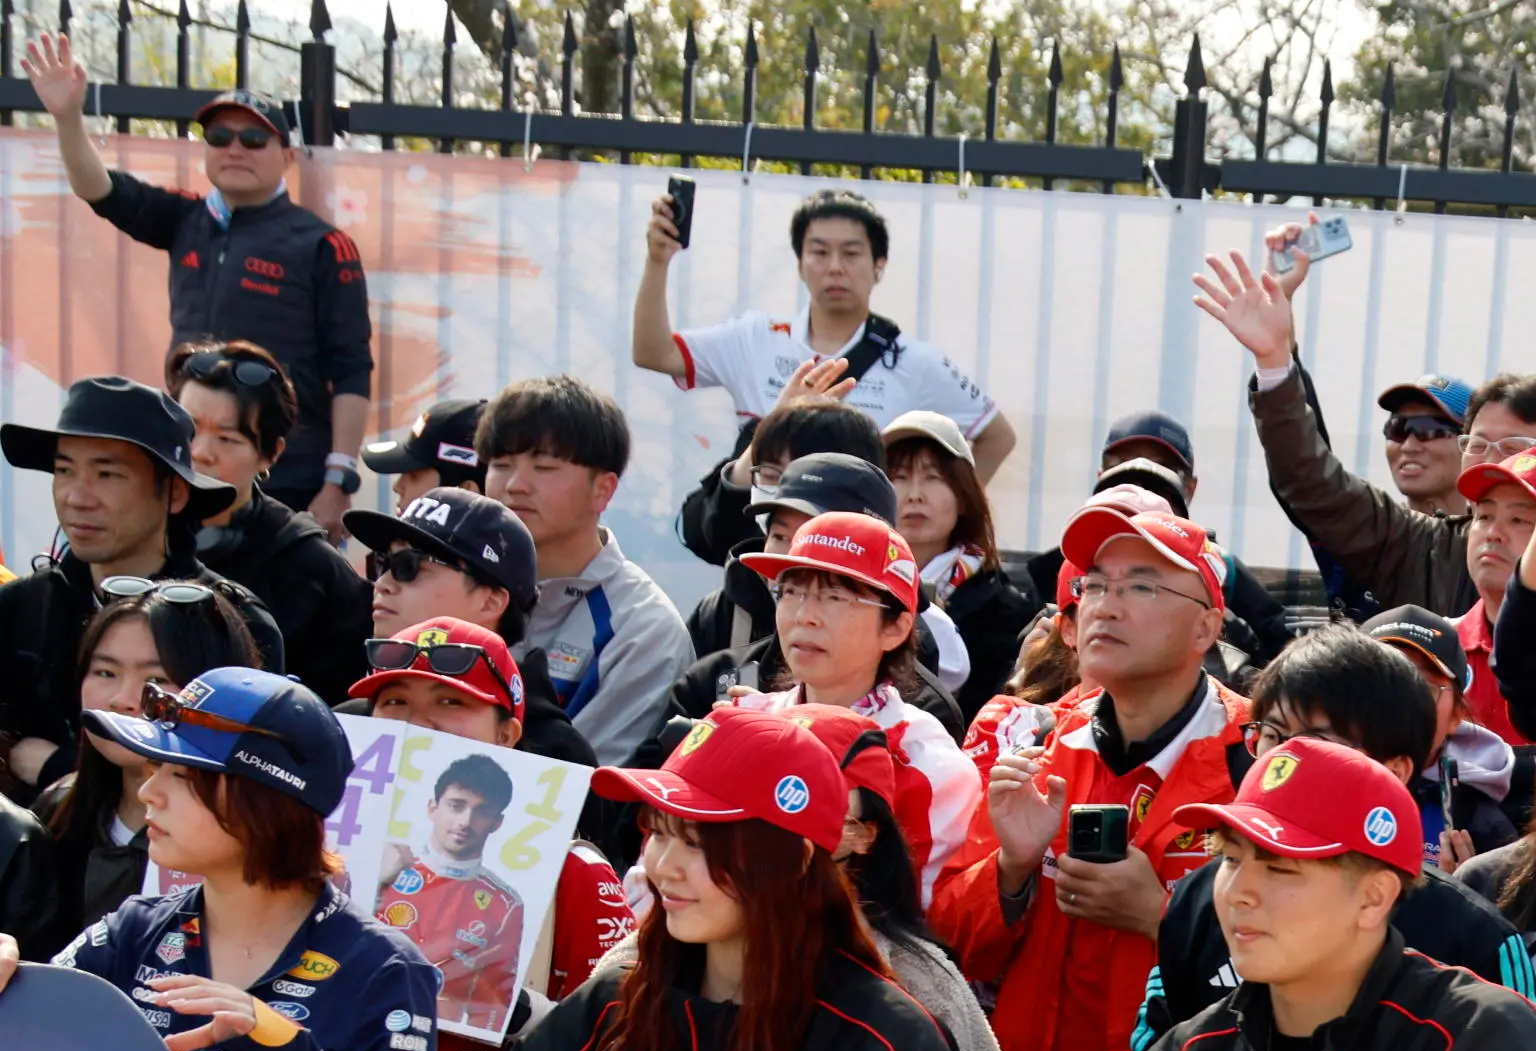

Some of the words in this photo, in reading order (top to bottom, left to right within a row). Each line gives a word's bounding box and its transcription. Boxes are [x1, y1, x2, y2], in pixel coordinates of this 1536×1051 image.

[796, 531, 866, 557] antander
[235, 750, 307, 791] ALPHATAURI
[778, 776, 807, 810] hp
[1368, 808, 1394, 844] hp
